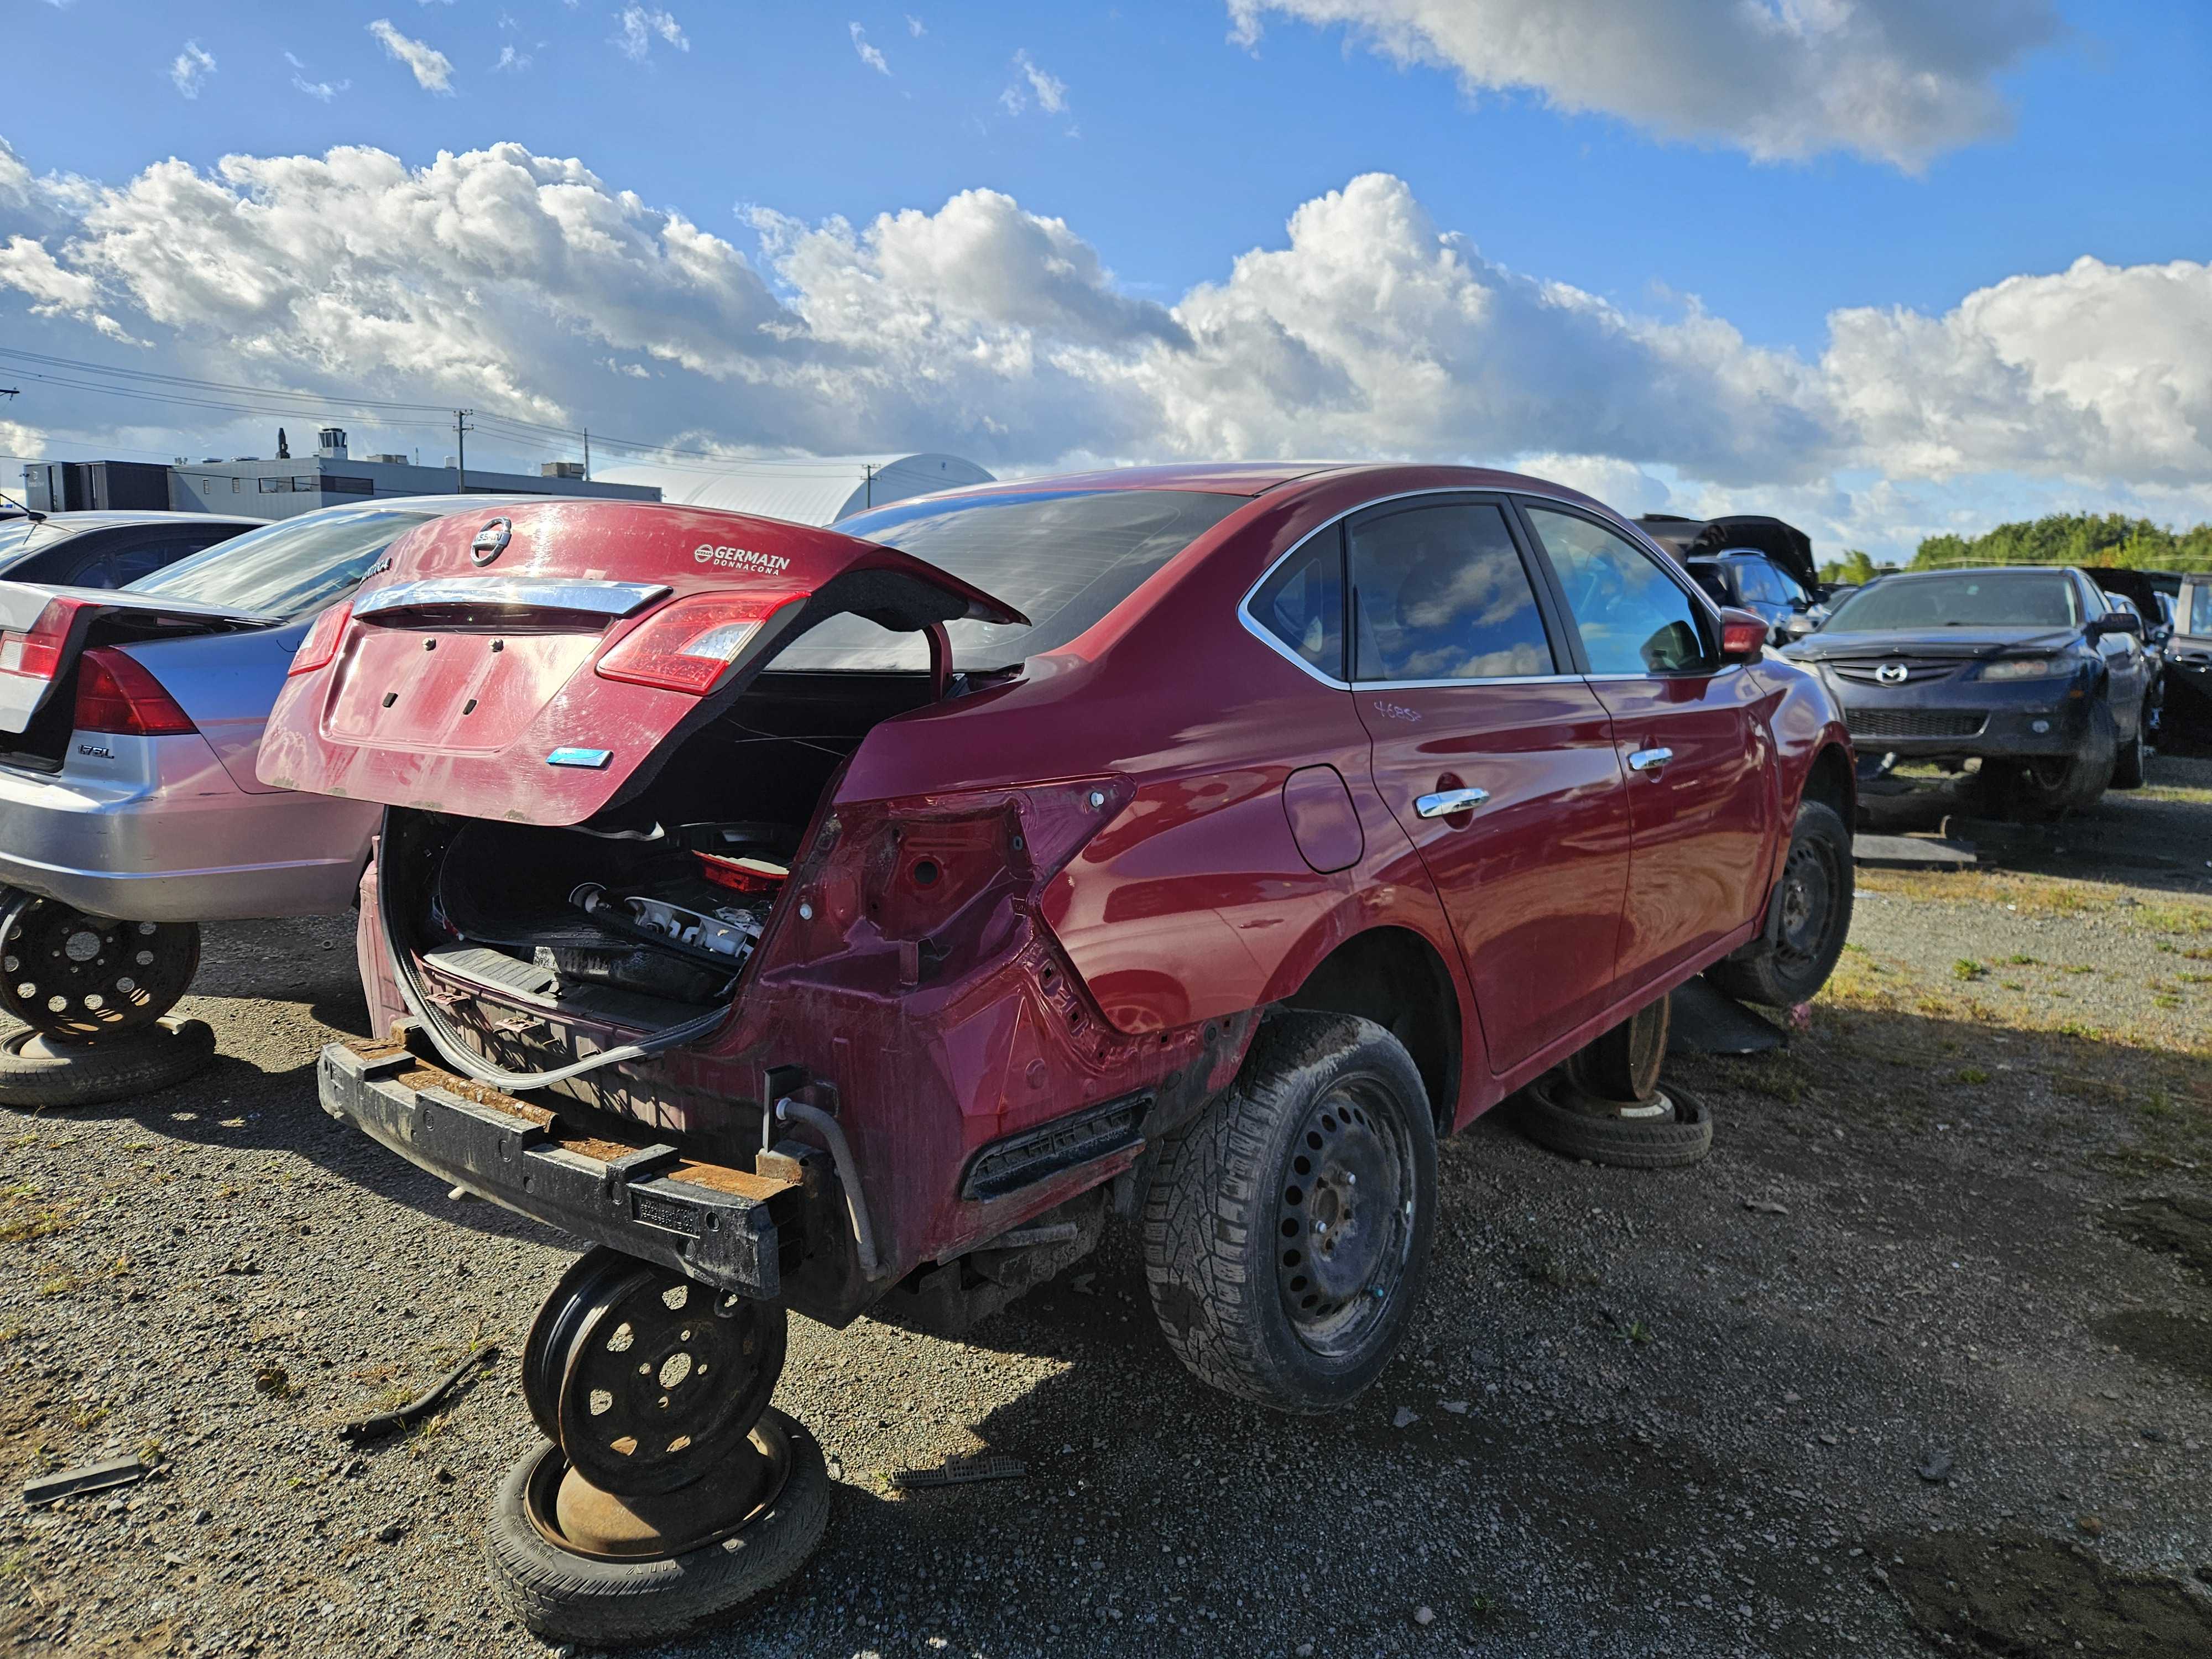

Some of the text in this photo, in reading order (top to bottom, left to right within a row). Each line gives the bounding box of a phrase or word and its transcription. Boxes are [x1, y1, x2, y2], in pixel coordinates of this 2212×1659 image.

[473, 533, 503, 542] SSAN
[714, 546, 790, 570] GERMAIN
[714, 558, 779, 576] DONNACONA
